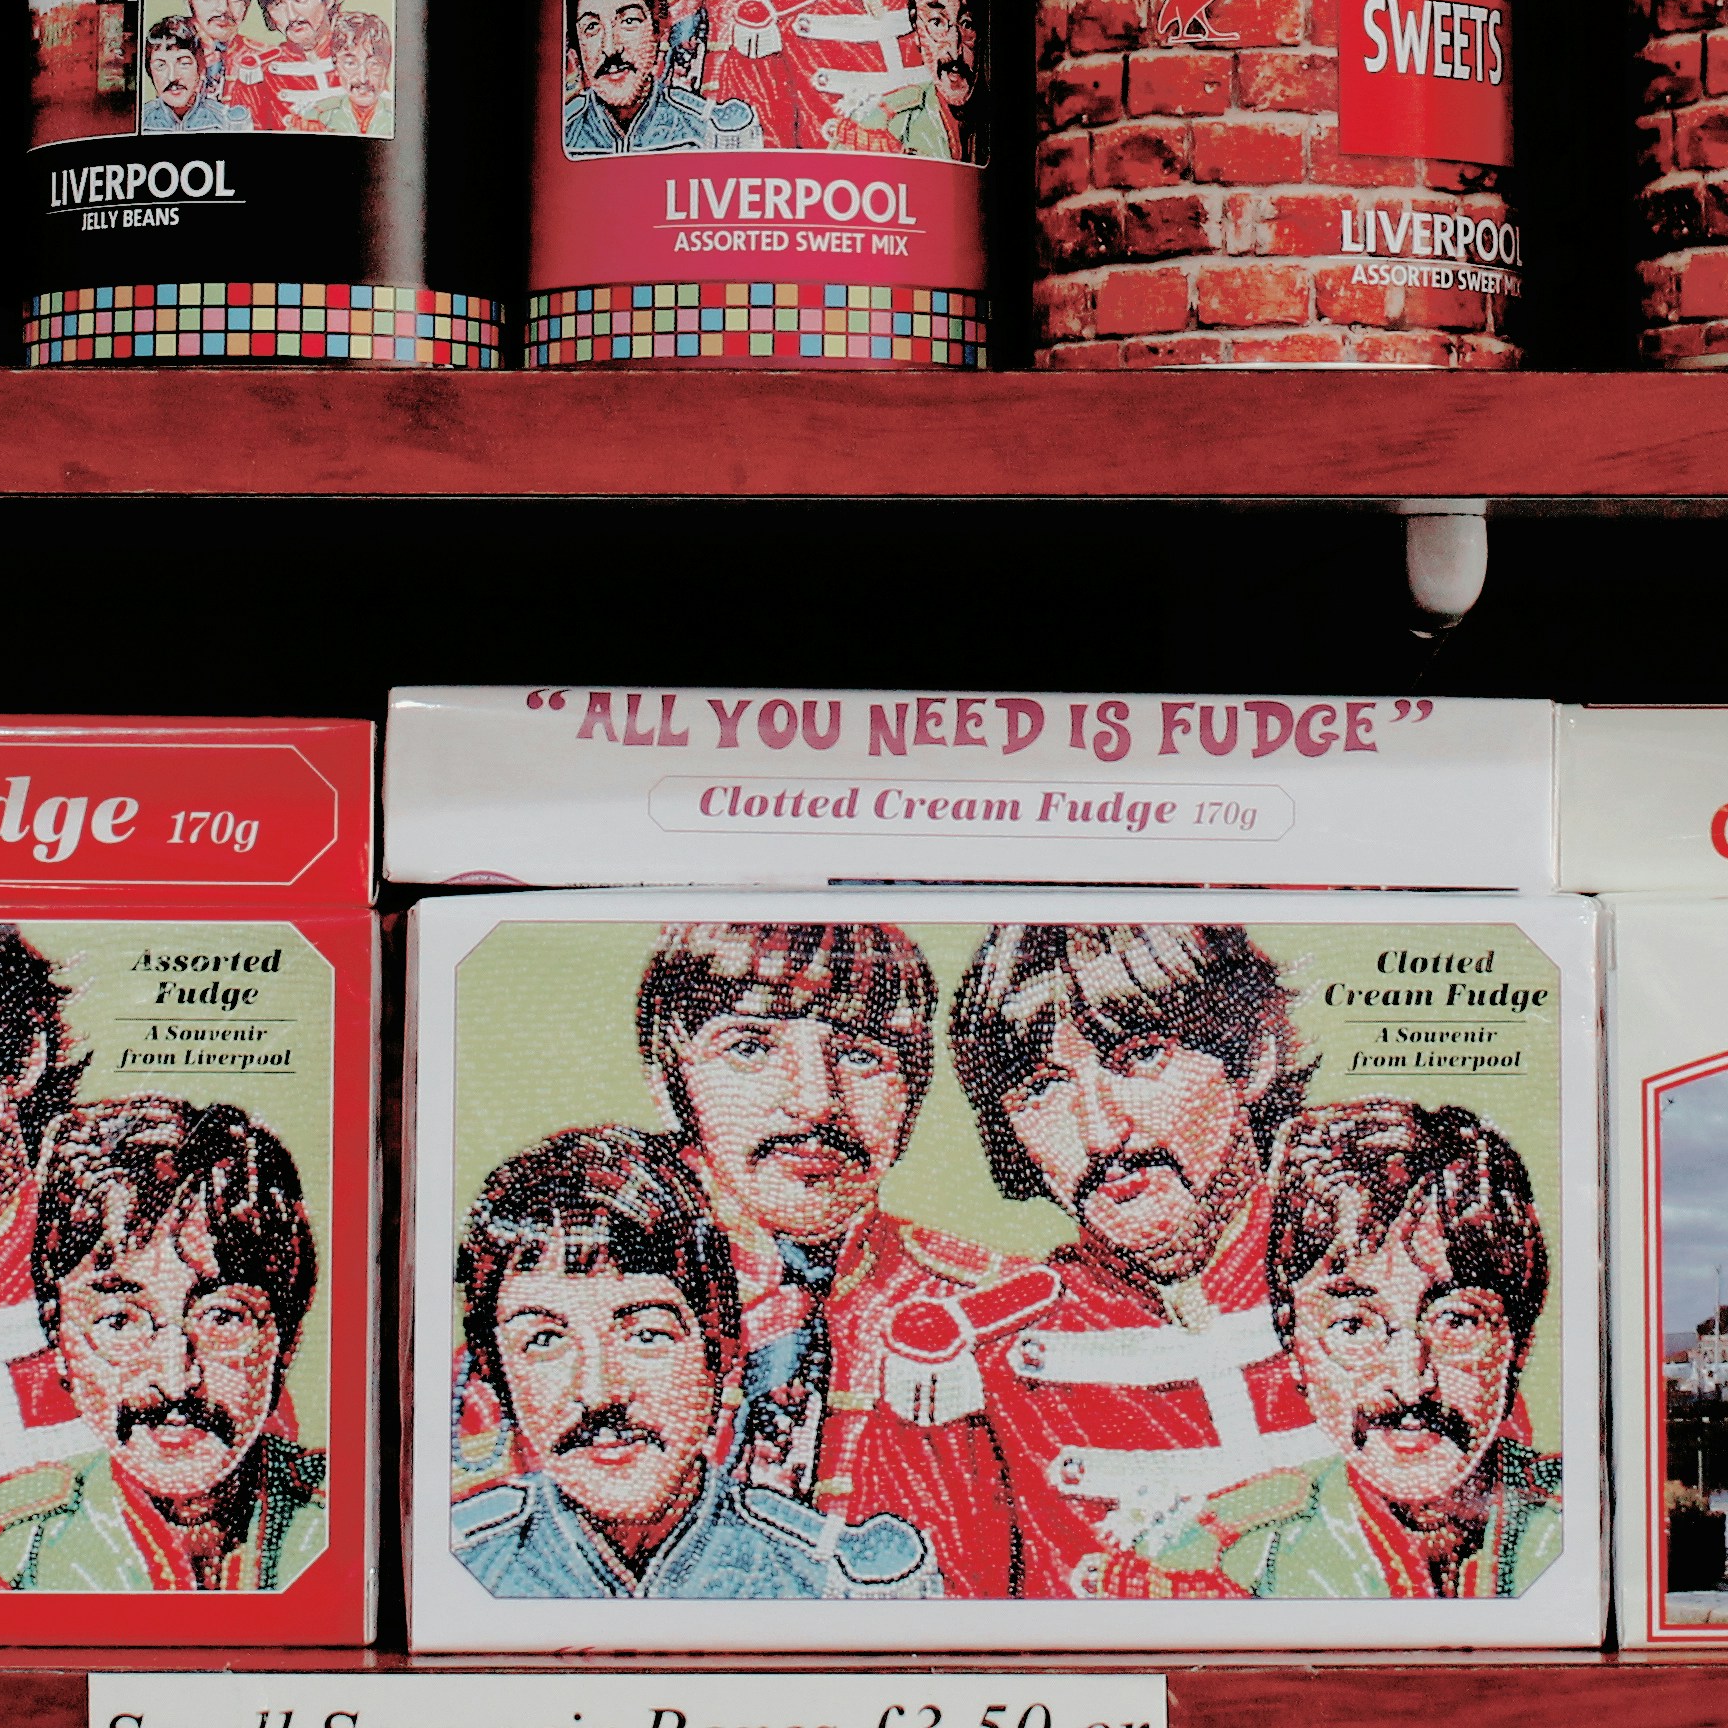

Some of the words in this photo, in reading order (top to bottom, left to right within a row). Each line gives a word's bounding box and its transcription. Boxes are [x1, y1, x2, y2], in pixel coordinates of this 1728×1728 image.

[51, 160, 235, 207] LIVERPOOL
[666, 178, 917, 225] LIVERPOOL
[82, 211, 117, 231] JELLY
[123, 207, 179, 227] BEANS
[674, 231, 789, 253] ASSORTED
[796, 232, 865, 254] SWEET
[872, 234, 910, 256] MIX
[1341, 209, 1522, 266] LIVERPOOL
[1351, 264, 1454, 289] ASSORTED
[1458, 270, 1503, 293] SWEET
[706, 697, 841, 751] YOU
[868, 697, 1046, 759] NEED
[1071, 699, 1131, 762] IS
[698, 785, 858, 823] Clotted
[872, 786, 1023, 825] Cream
[1036, 789, 1176, 832] Fudge
[1193, 797, 1258, 832] 170g
[166, 810, 260, 852] 170g
[132, 948, 282, 972] Assorted
[1378, 949, 1494, 974] Clotted
[156, 982, 258, 1011] Fudge
[1325, 982, 1433, 1006] Cream
[1446, 983, 1548, 1012] Fudge
[144, 1026, 158, 1040] A
[166, 1025, 268, 1041] Souvenir
[1375, 1027, 1389, 1043] A
[1396, 1027, 1498, 1043] Souvenir
[117, 1048, 175, 1068] from
[185, 1050, 290, 1069] Liverpool
[1348, 1051, 1406, 1071] from
[1415, 1051, 1520, 1071] Liverpool
